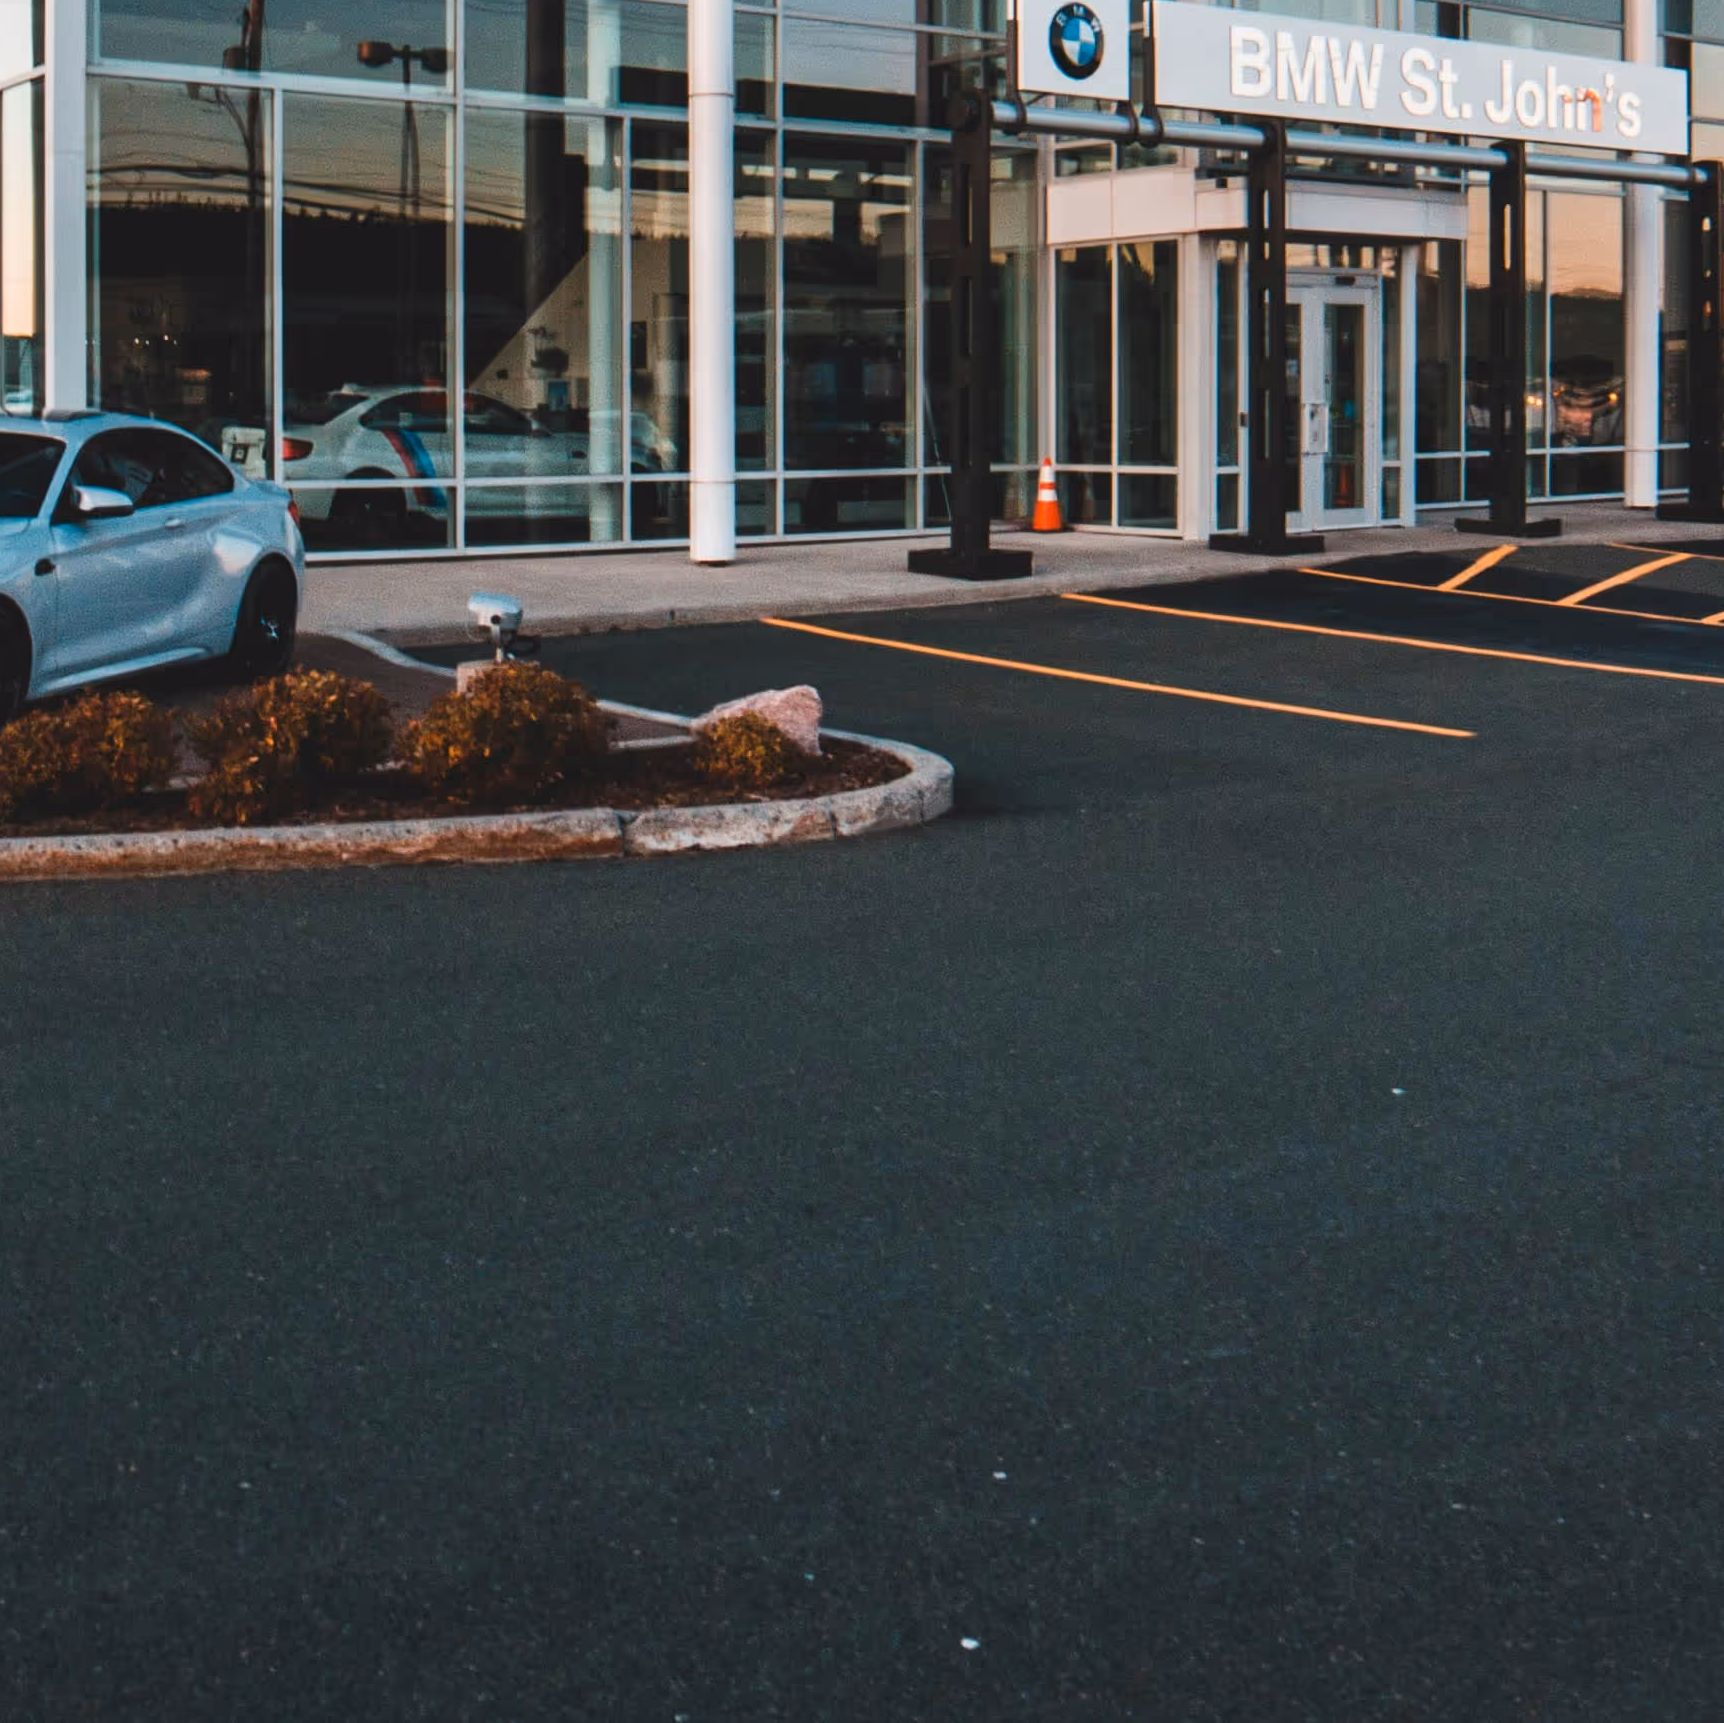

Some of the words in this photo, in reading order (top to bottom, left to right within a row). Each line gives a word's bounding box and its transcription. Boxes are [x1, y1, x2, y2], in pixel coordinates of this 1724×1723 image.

[1230, 25, 1384, 110] BMW
[1399, 47, 1474, 119] St.
[1484, 59, 1643, 139] John's
